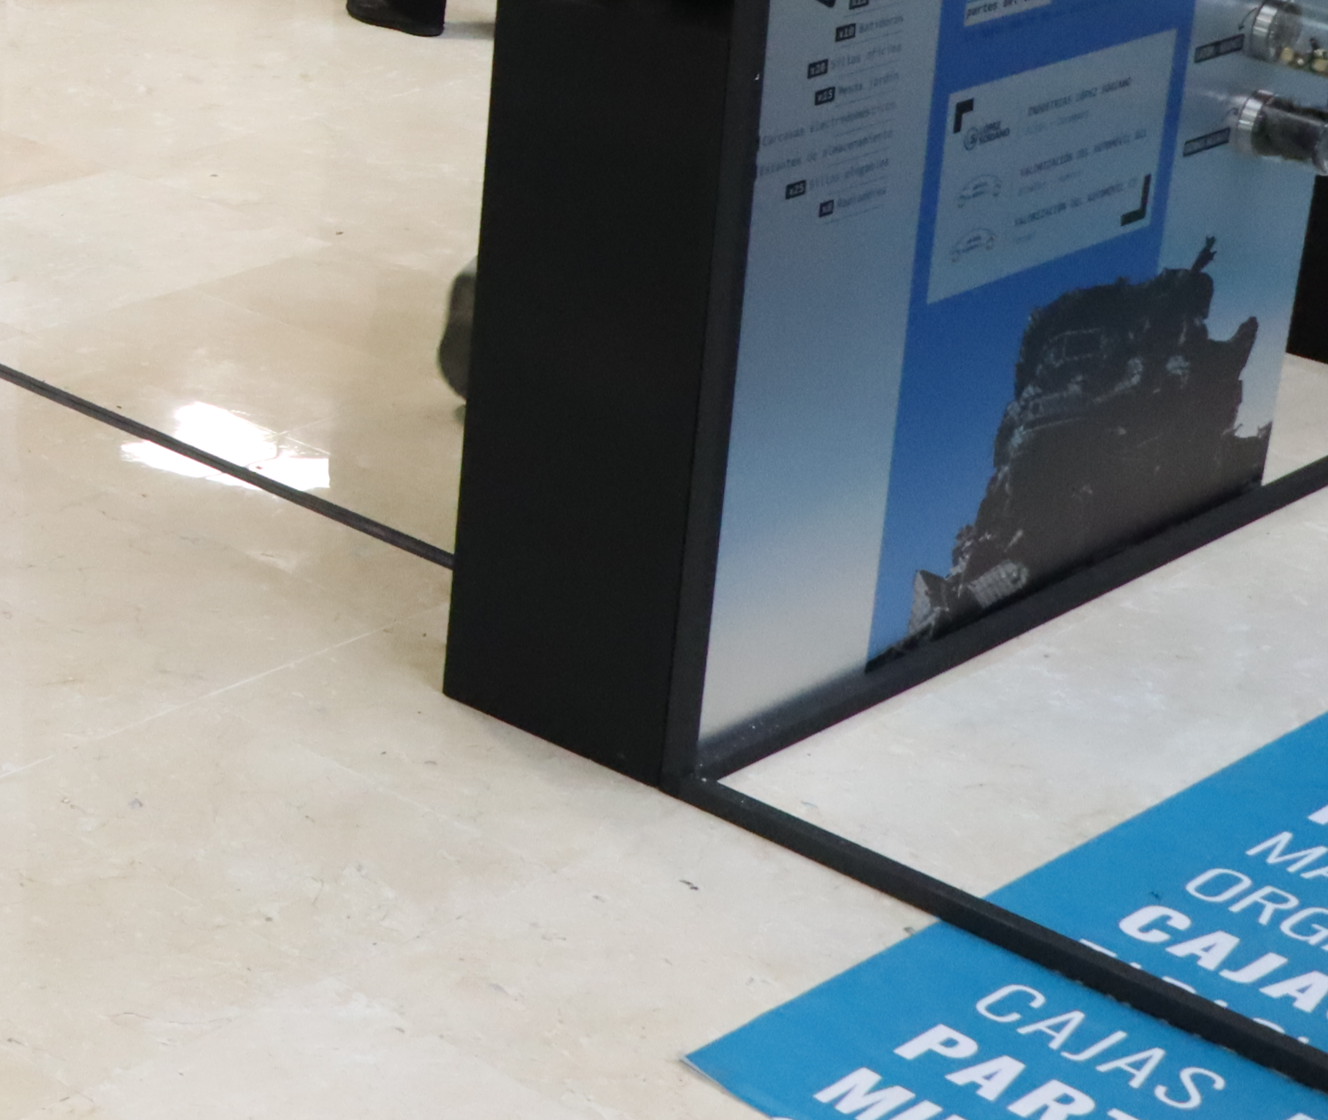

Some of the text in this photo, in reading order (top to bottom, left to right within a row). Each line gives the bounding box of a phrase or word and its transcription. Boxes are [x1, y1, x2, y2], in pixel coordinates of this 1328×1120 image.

[1118, 904, 1328, 1013] CAJA
[1185, 868, 1328, 951] ORG
[893, 1023, 1129, 1120] PAR
[975, 984, 1225, 1110] CAJAS
